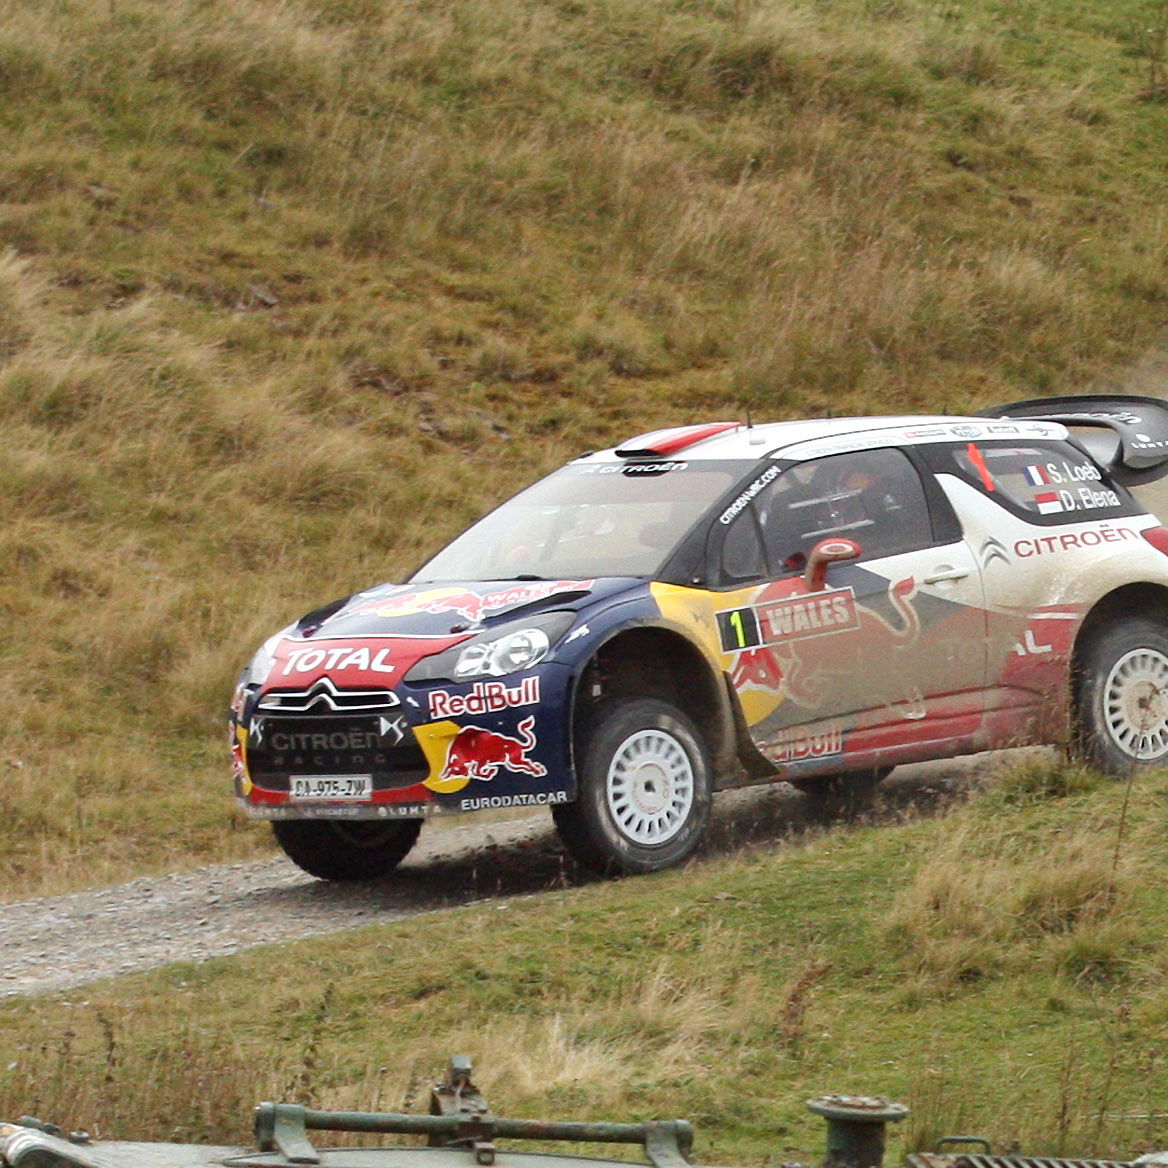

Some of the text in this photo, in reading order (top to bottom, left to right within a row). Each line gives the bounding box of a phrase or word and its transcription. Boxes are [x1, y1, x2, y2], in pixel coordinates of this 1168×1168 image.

[1064, 461, 1102, 482] Loeb
[1081, 487, 1121, 510] Elena
[730, 596, 850, 648] 1 WALES
[283, 647, 396, 675] TOTAL
[429, 676, 541, 719] Red Bull
[460, 790, 568, 812] EURODATACAR
